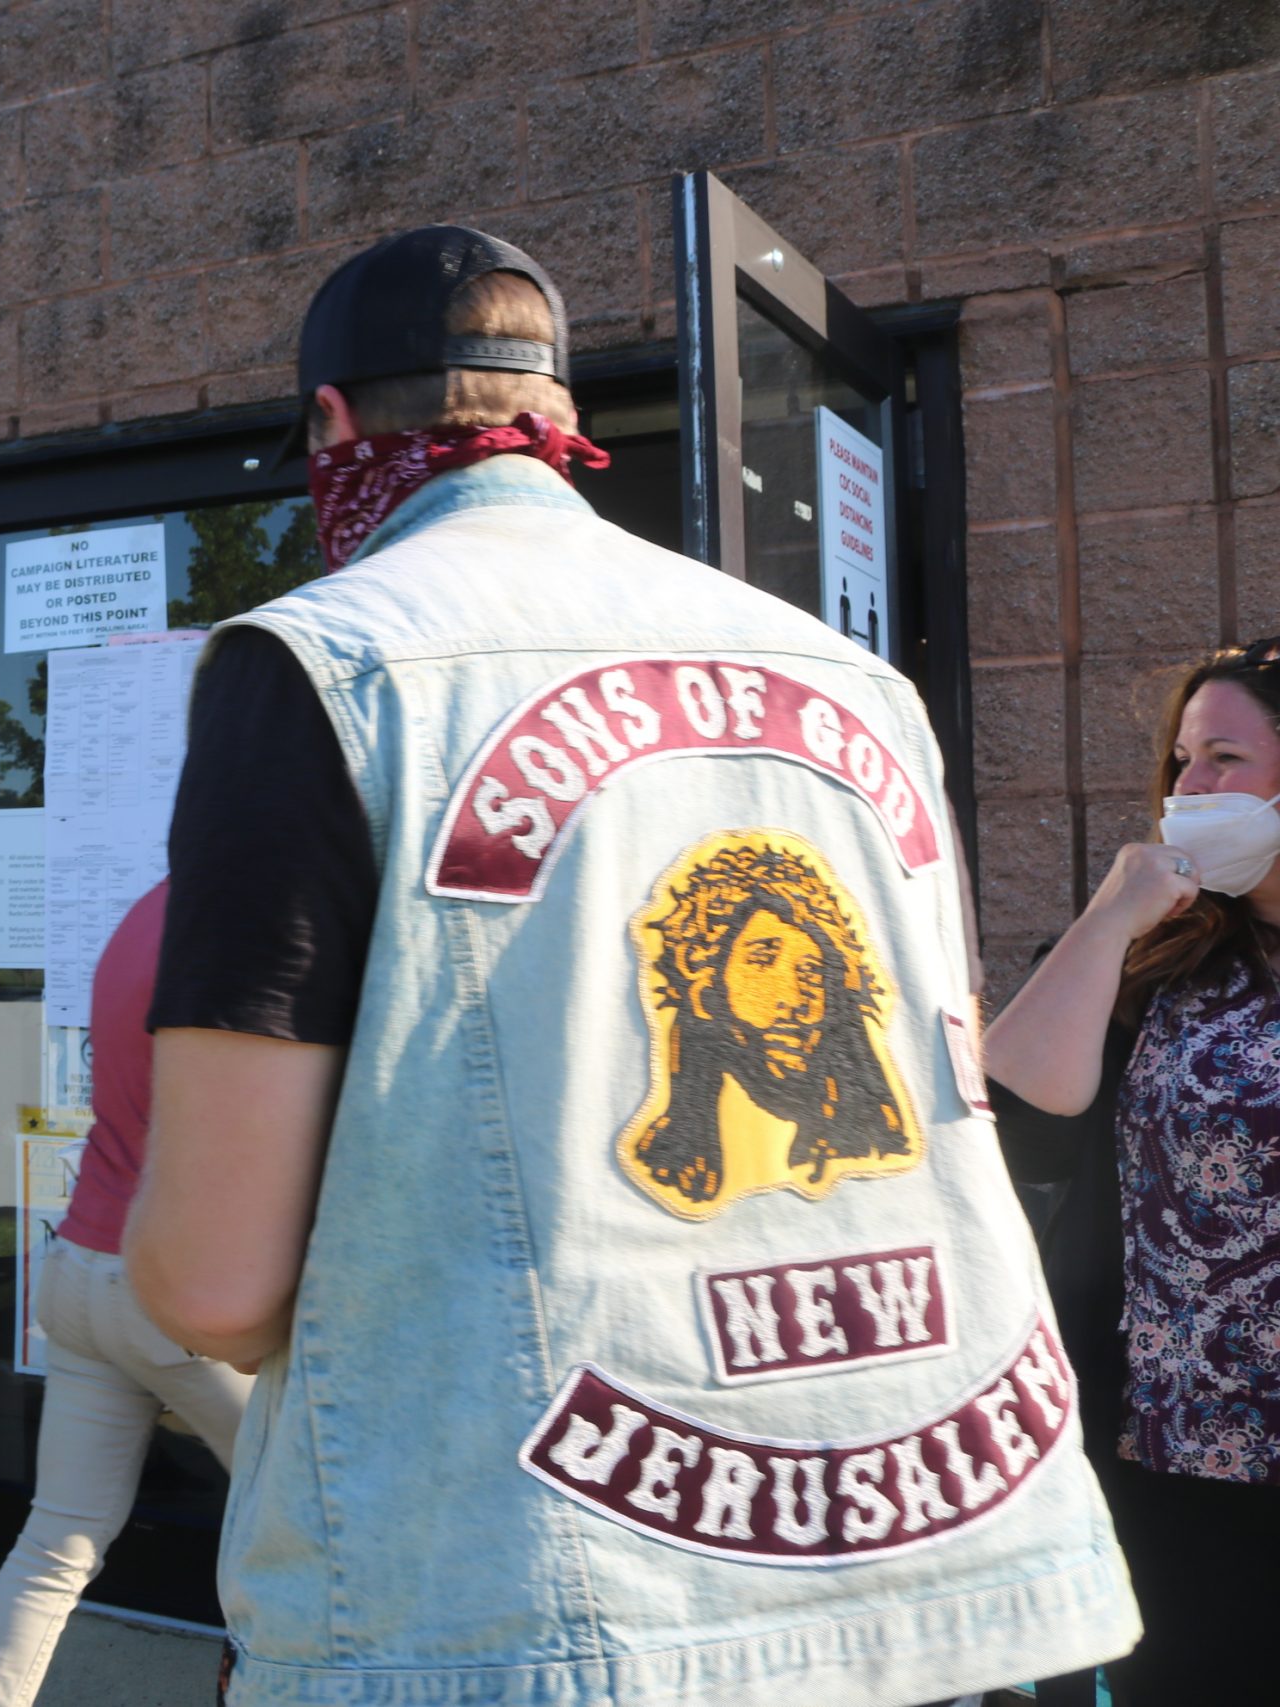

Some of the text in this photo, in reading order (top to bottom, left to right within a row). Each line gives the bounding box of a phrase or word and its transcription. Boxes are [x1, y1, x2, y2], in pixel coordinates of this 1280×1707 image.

[829, 437, 879, 485] PLEASE MAINTAIN
[839, 472, 872, 508] CDC SOCIAL
[839, 500, 874, 535] DISTANCING
[70, 540, 90, 553] NO
[840, 529, 874, 562] GUIDELINES
[11, 551, 159, 579] CAMPAIGN LITERATURE
[16, 570, 151, 596] MAY BE DISTRIBUTED
[45, 591, 118, 610] OR POSTED
[19, 607, 148, 630] BEYOND THIS POINT
[472, 665, 917, 860] SONS OF GOD
[713, 1256, 933, 1368] NEW
[548, 1328, 1068, 1547] JERUSALEM
